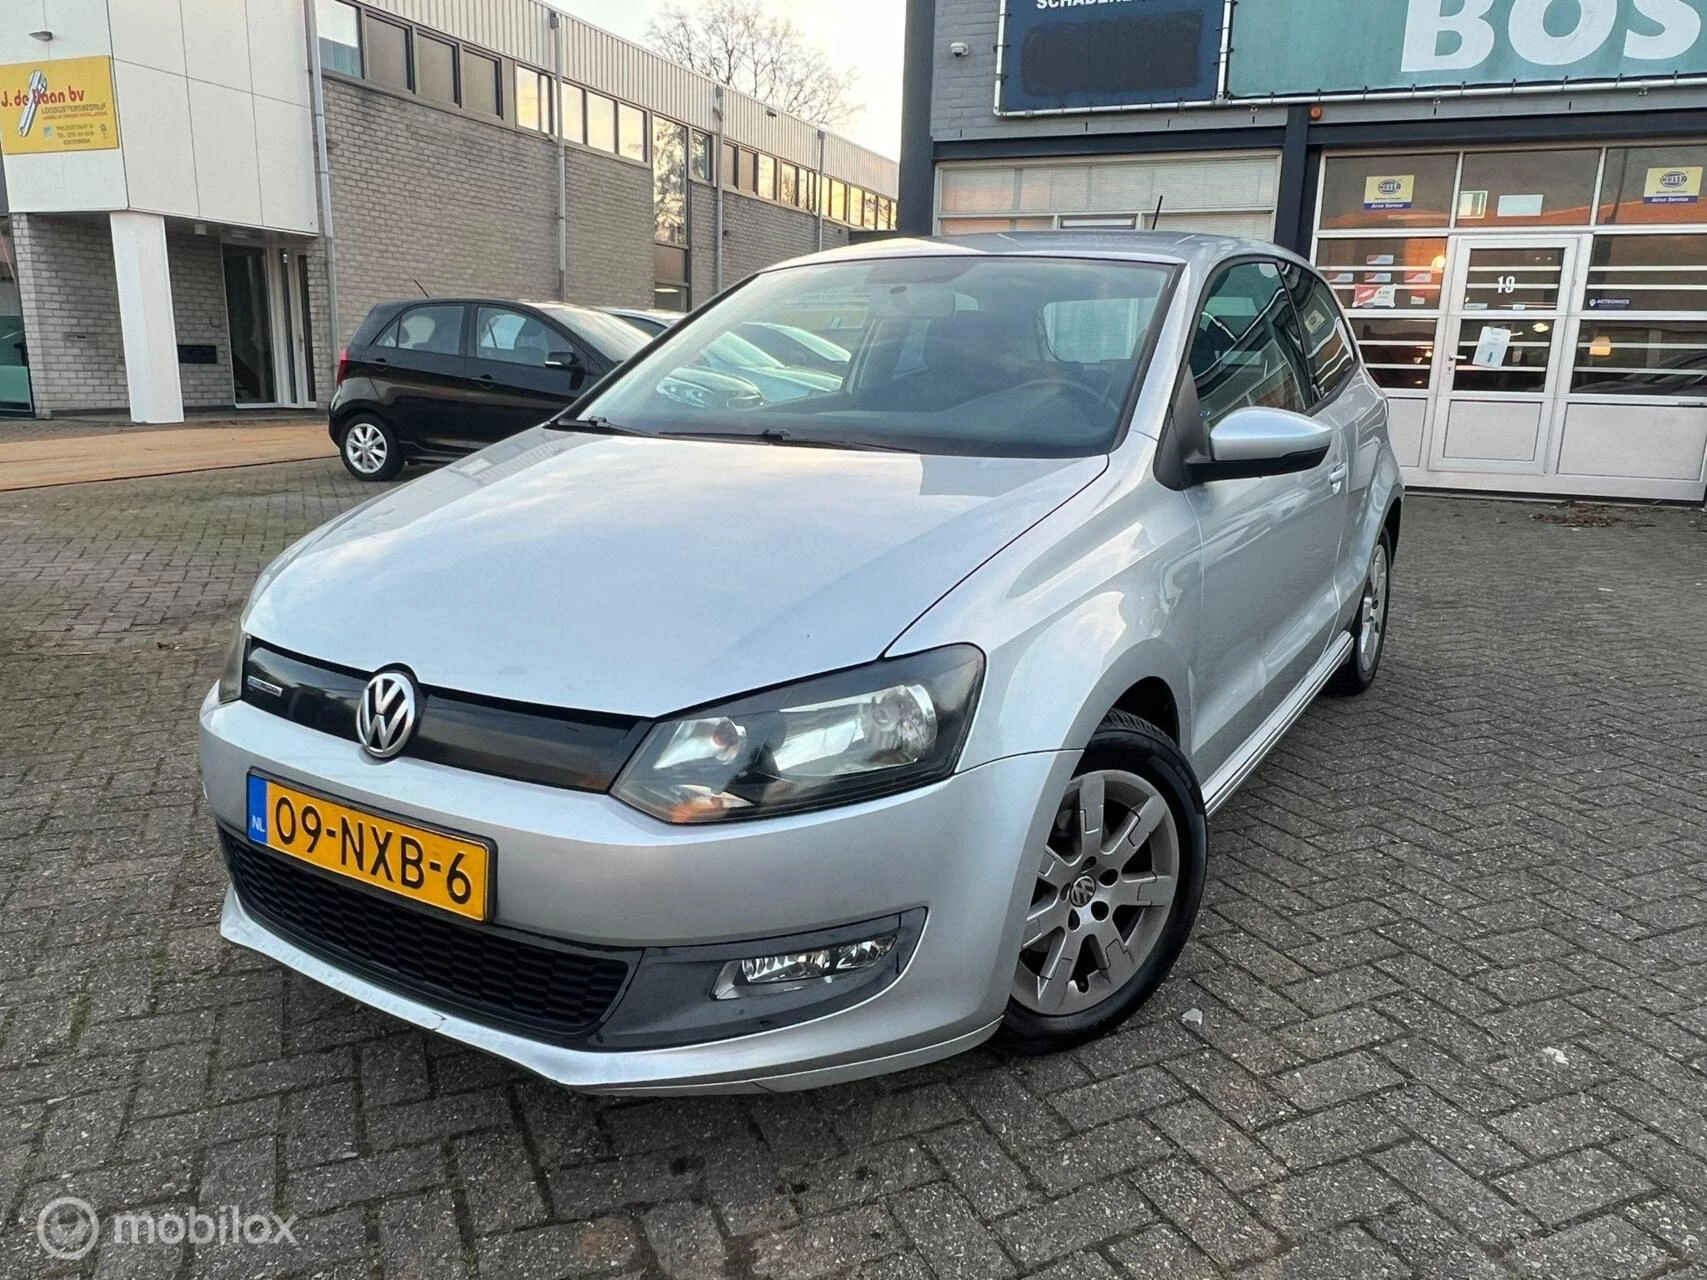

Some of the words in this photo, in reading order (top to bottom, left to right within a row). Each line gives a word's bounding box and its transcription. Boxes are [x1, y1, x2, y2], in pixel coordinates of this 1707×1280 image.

[1400, 0, 1701, 72] BOS
[1, 90, 12, 107] J.
[14, 89, 29, 106] de
[68, 85, 84, 102] bv
[1497, 275, 1516, 294] 19
[251, 814, 265, 834] NL
[275, 795, 472, 905] 09-NXB-6
